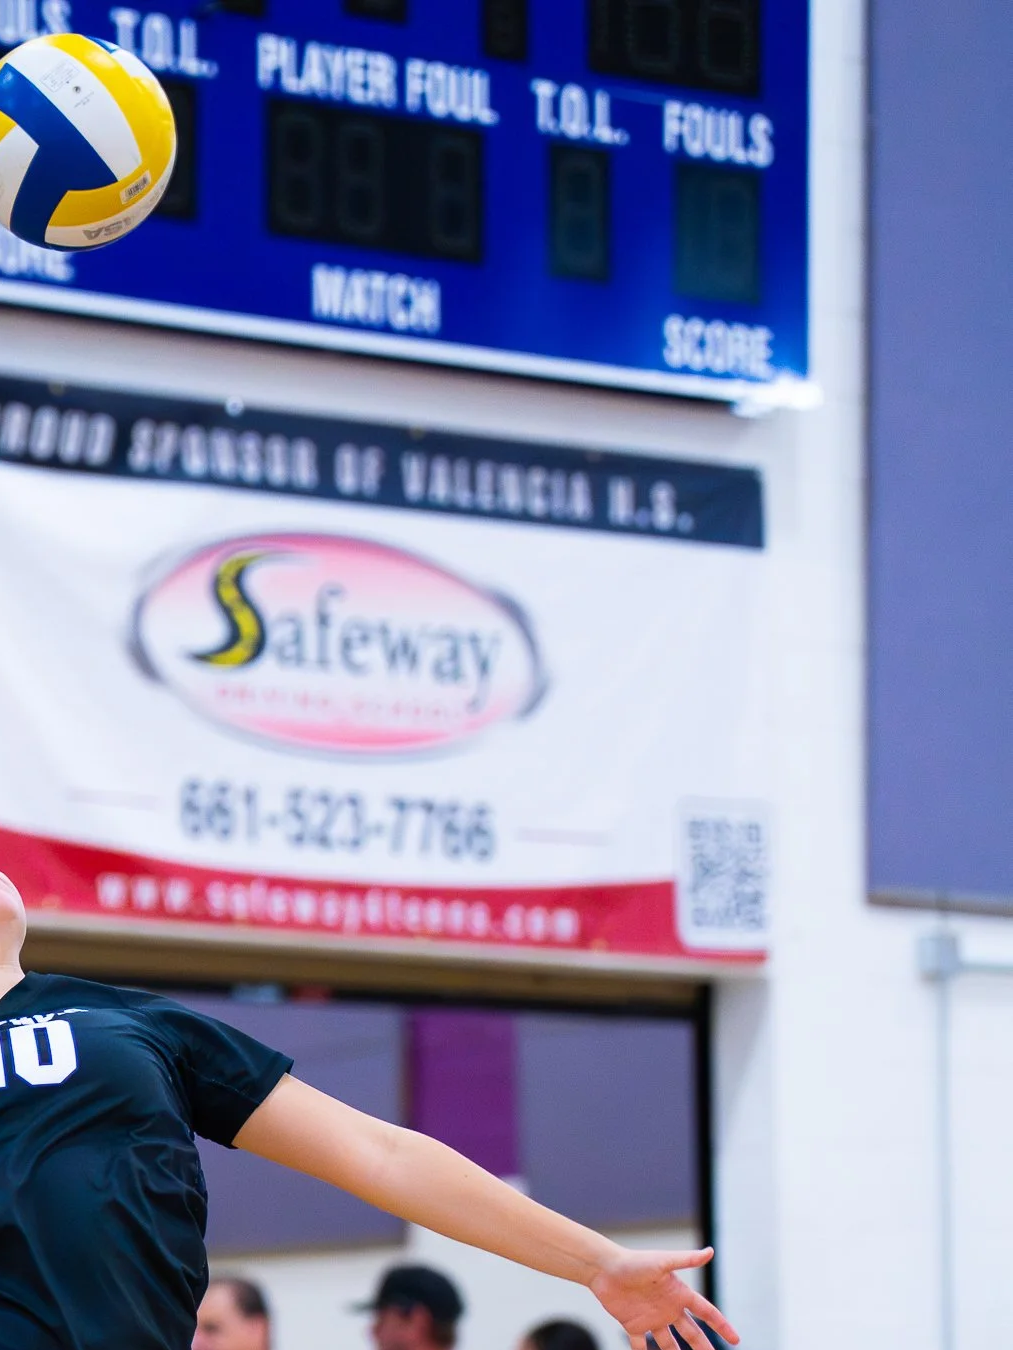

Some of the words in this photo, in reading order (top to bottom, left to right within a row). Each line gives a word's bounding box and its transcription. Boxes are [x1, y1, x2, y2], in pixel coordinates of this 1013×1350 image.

[110, 7, 218, 78] TO.L.
[257, 34, 397, 108] PLAYER
[663, 101, 774, 167] FOULS
[312, 264, 441, 333] MATCH
[663, 315, 773, 379] SCORE
[128, 418, 319, 489] SPONSOR
[334, 442, 384, 498] OF
[401, 451, 592, 521] VALENCIA
[186, 548, 500, 712] Safeway
